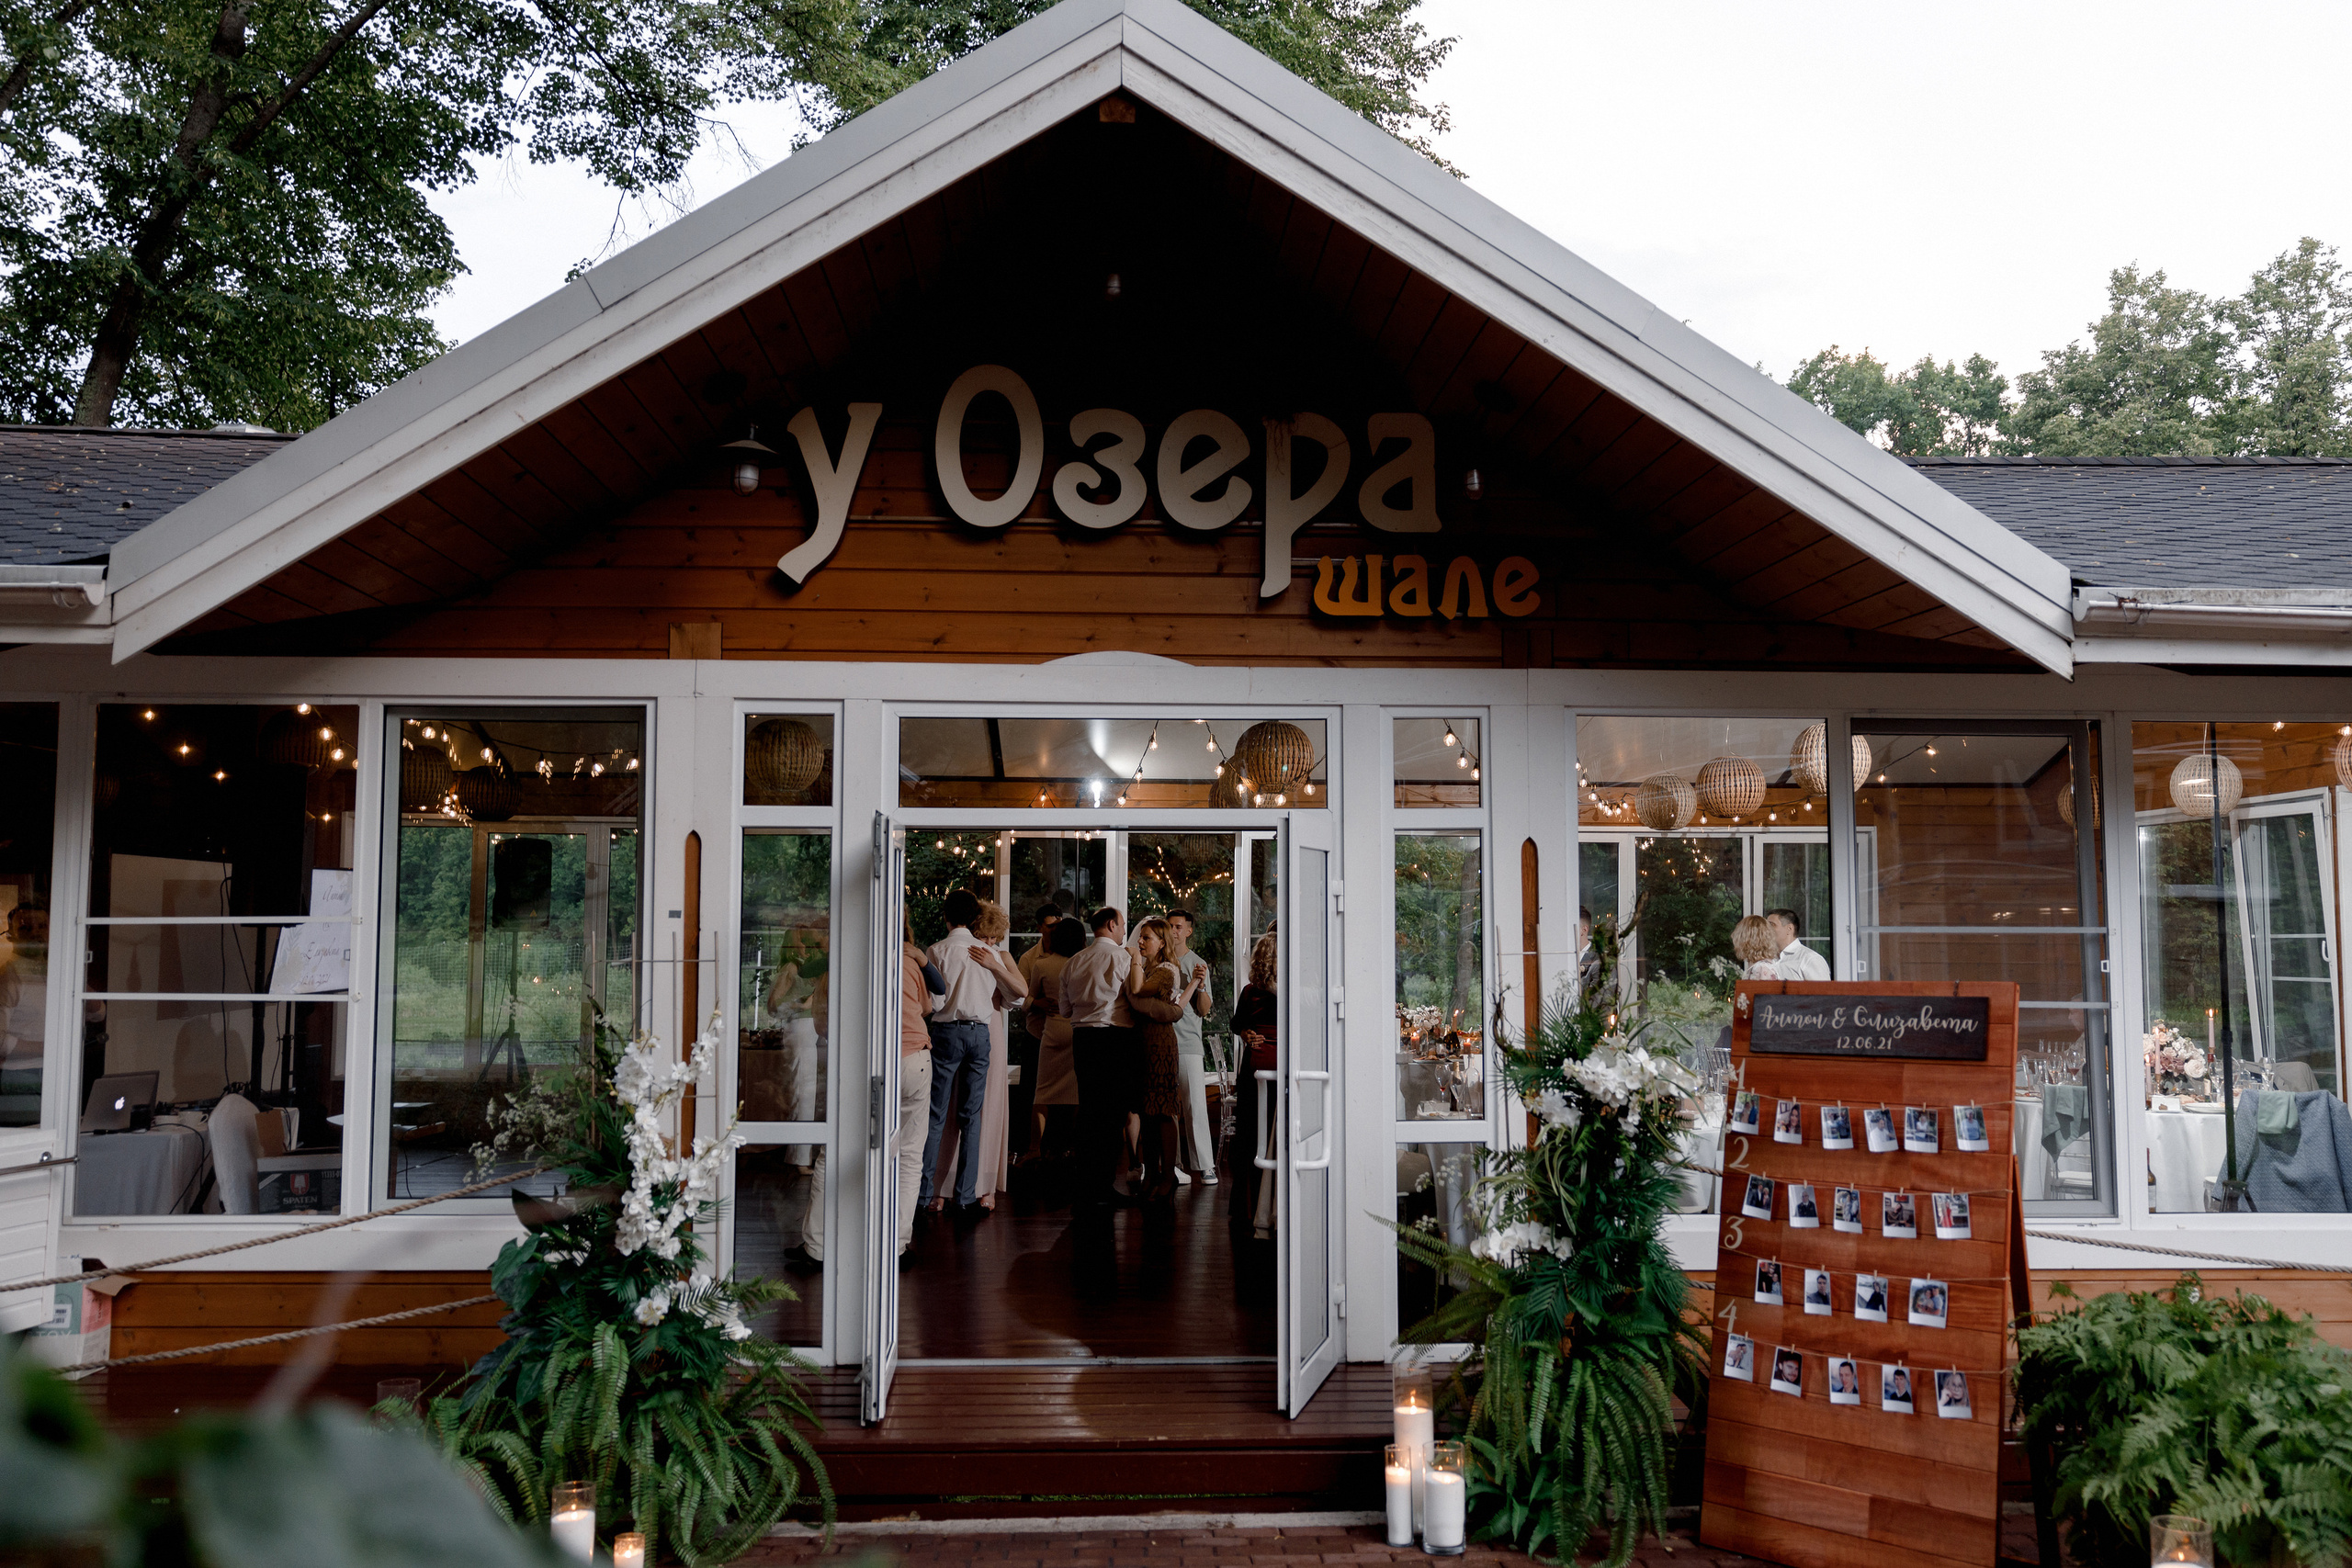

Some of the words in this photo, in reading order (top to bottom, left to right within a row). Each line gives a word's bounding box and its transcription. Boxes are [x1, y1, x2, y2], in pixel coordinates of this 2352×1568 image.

[935, 365, 1442, 598] Озера
[1313, 554, 1541, 620] шале
[1759, 1005, 1828, 1030] Антон
[1831, 1007, 1848, 1030] &
[1853, 1005, 1979, 1039] Елизавета
[1837, 1036, 1893, 1050] 12.06.21
[1736, 1057, 1746, 1090] 1
[1729, 1136, 1750, 1168] 2
[283, 1196, 318, 1205] SPATEN
[1724, 1215, 1746, 1249] 3
[1718, 1299, 1737, 1334] 4
